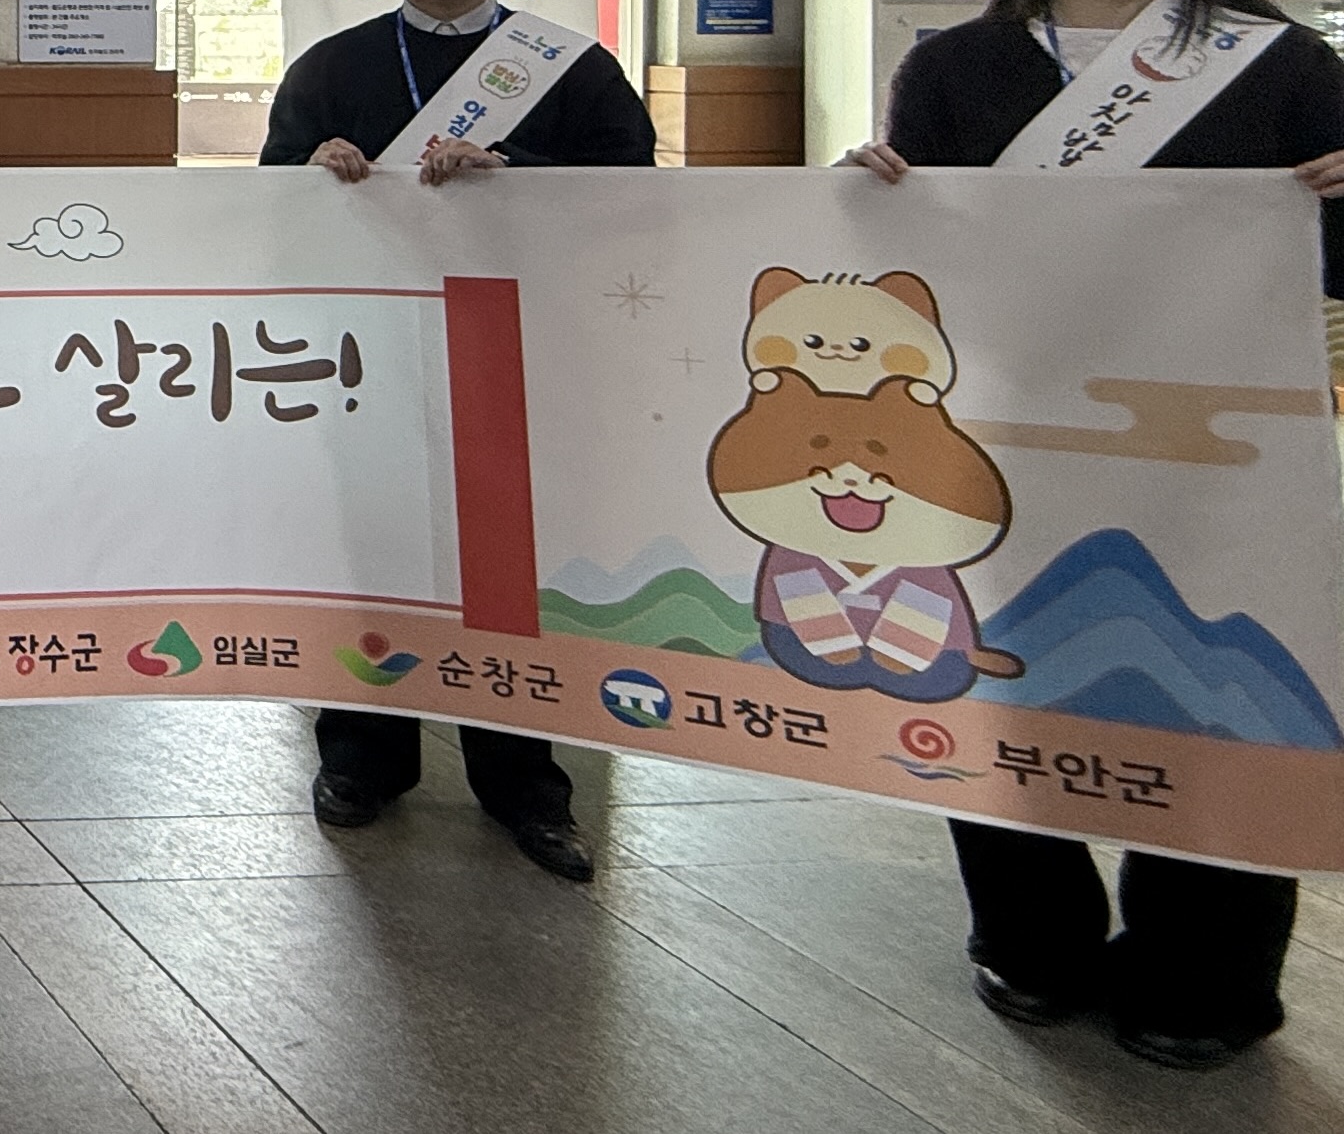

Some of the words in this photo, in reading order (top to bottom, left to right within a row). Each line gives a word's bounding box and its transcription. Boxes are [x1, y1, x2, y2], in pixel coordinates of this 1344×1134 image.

[49, 46, 87, 55] KORAIL
[54, 319, 364, 427] 살리는!
[7, 633, 102, 676] 장수군
[212, 634, 299, 669] 임실군
[436, 650, 564, 703] 순창군
[684, 689, 830, 750] 고창군
[994, 739, 1176, 810] 부안군
